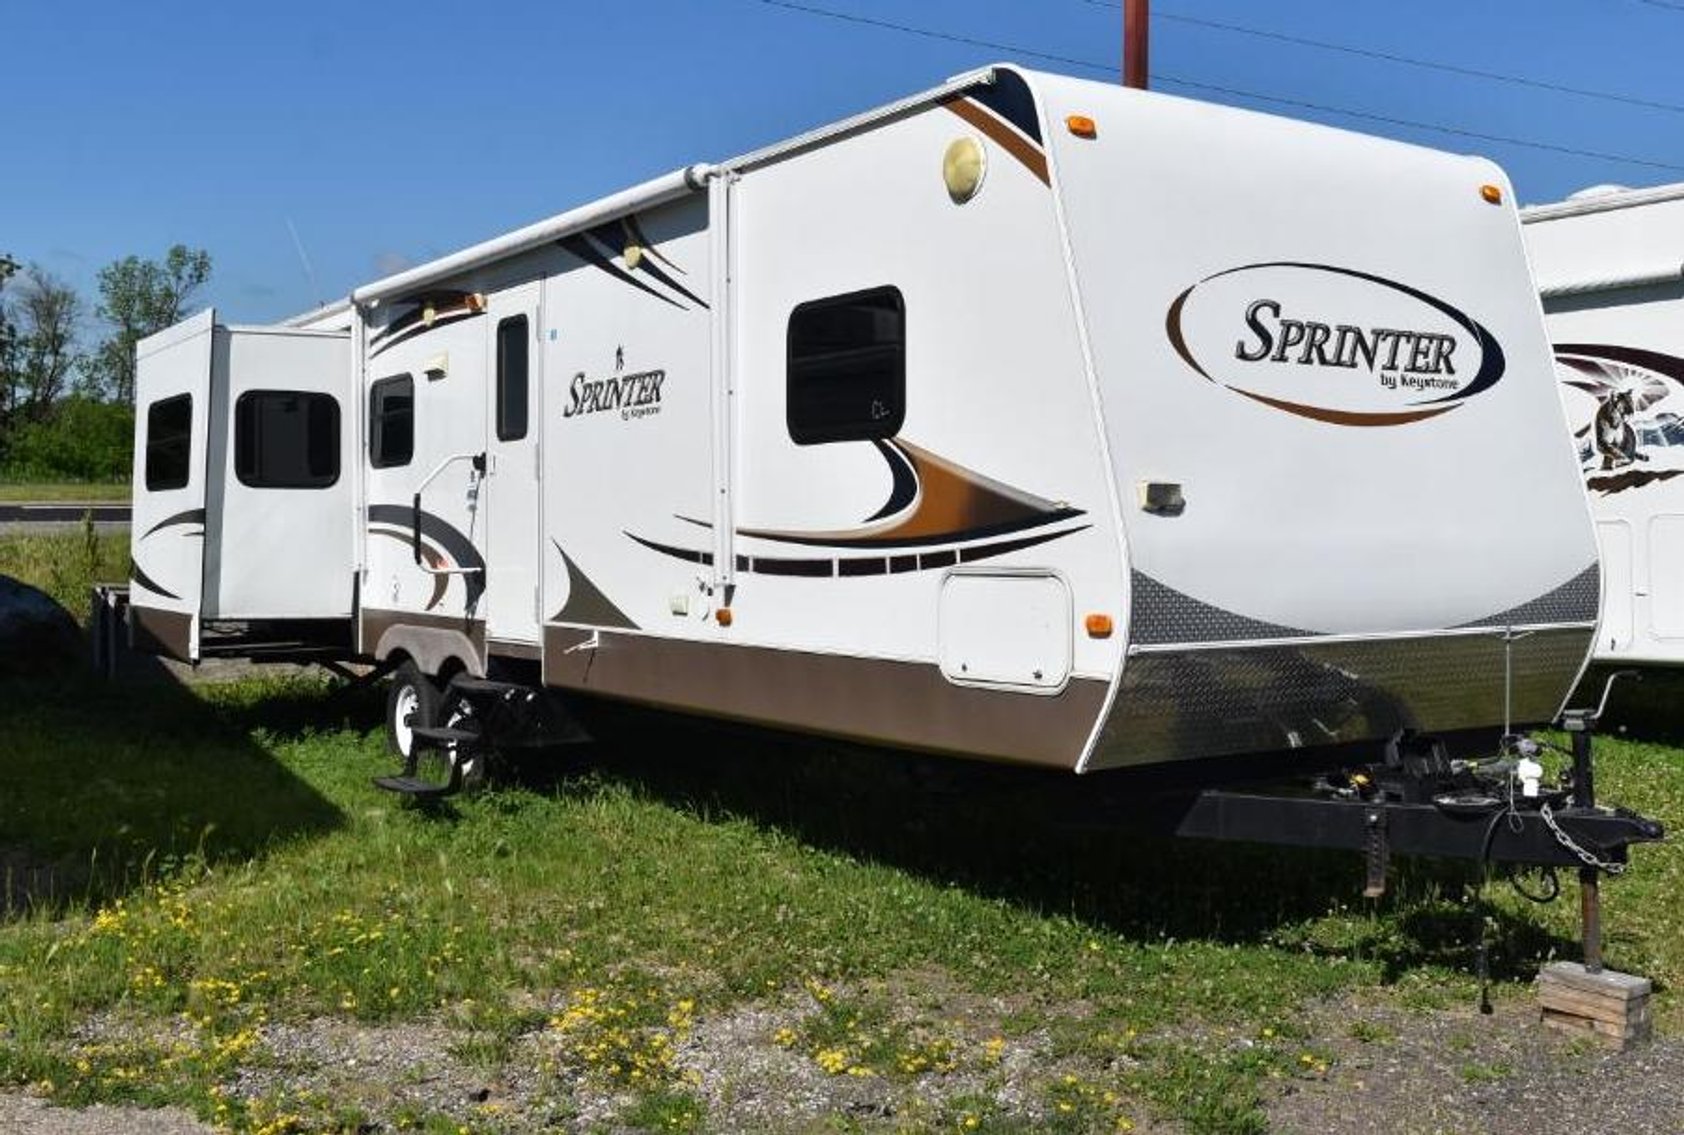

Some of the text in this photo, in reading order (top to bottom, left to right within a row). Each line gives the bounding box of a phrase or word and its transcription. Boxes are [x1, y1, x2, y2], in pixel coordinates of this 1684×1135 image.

[1235, 299, 1457, 374] SPRINTER
[563, 369, 666, 418] SPRINTER
[1380, 373, 1458, 391] by Keystone
